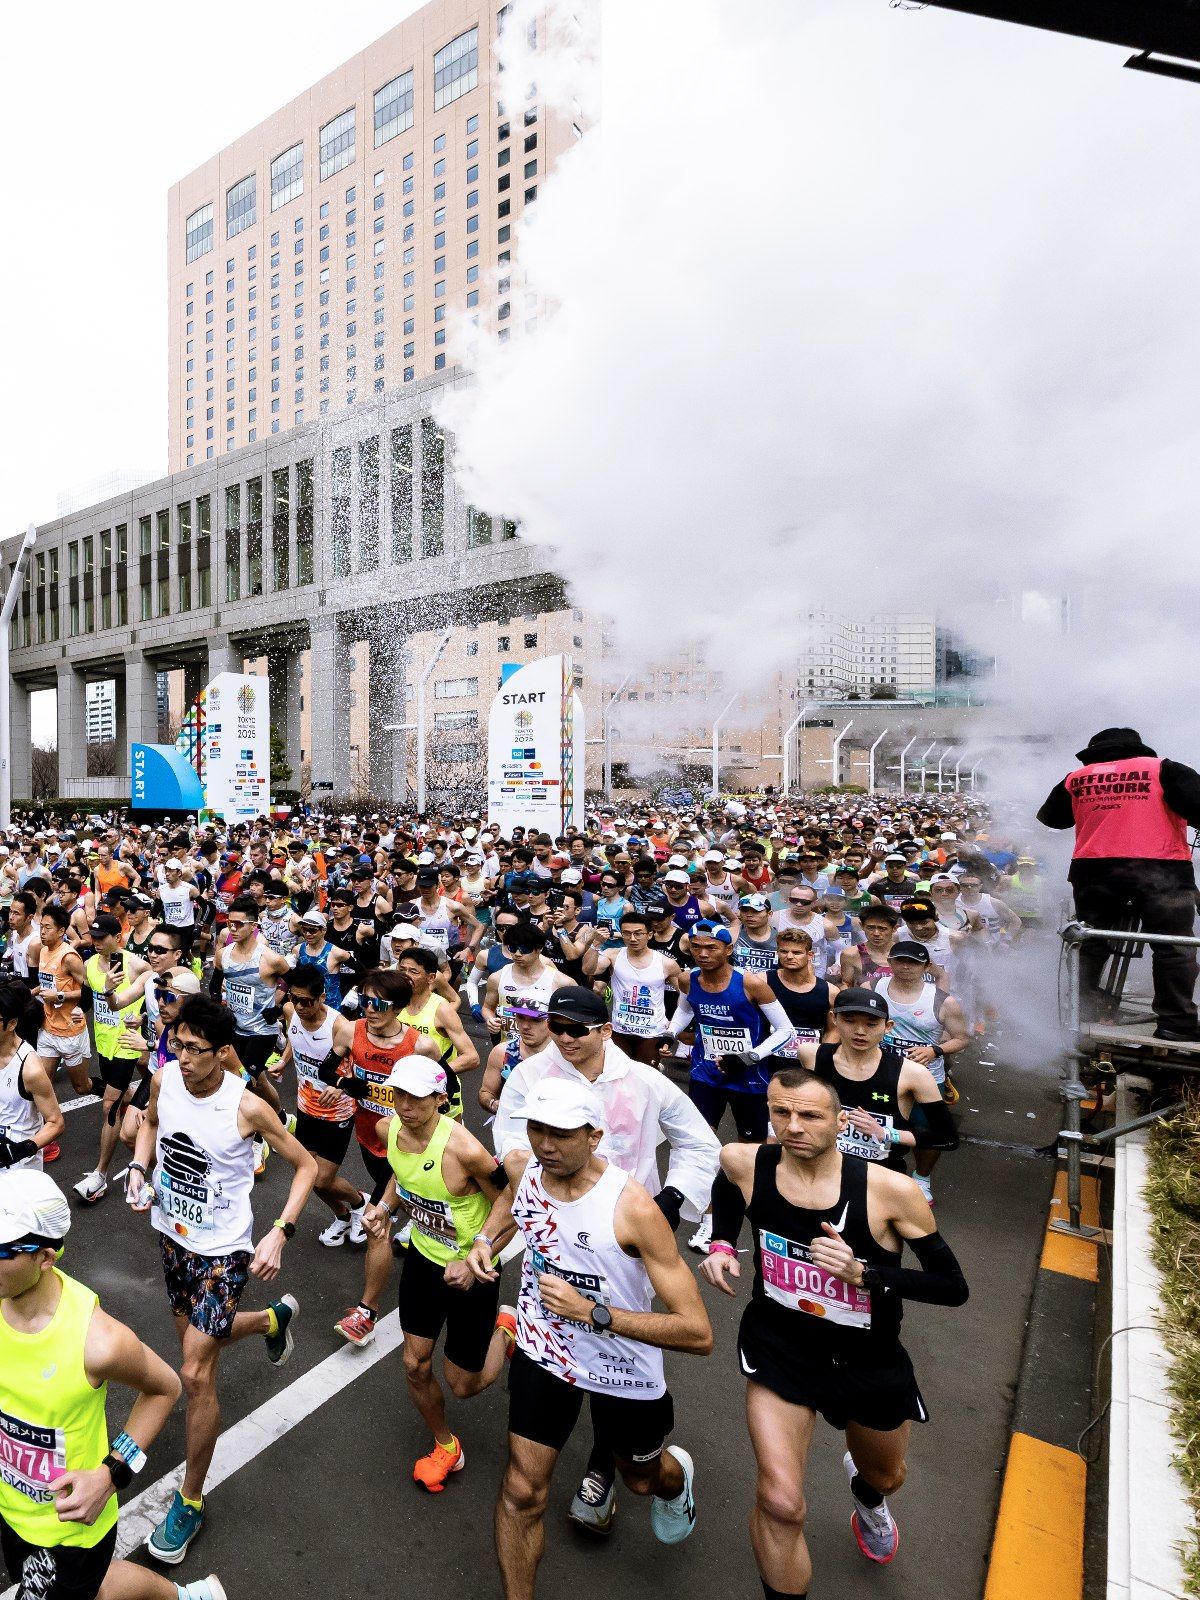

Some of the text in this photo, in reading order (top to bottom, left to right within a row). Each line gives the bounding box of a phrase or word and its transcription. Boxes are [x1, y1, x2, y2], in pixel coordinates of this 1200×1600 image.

[503, 692, 545, 704] START
[238, 730, 255, 738] 2025
[134, 751, 144, 799] START
[1071, 771, 1151, 788] OFFICIAL
[746, 956, 771, 968] 20431
[625, 1014, 650, 1026] 20232
[712, 1038, 744, 1052] 10020
[839, 1143, 879, 1158] STARTS
[172, 1181, 204, 1199] 東京メトロ
[169, 1194, 202, 1224] 19868
[764, 1255, 774, 1269] B
[784, 1262, 849, 1303] 10061
[599, 1353, 636, 1365] STAY
[604, 1365, 634, 1375] THE
[589, 1373, 658, 1388] COURSE.
[0, 1417, 51, 1443] 東京メトロ
[3, 1470, 53, 1502] STARTS
